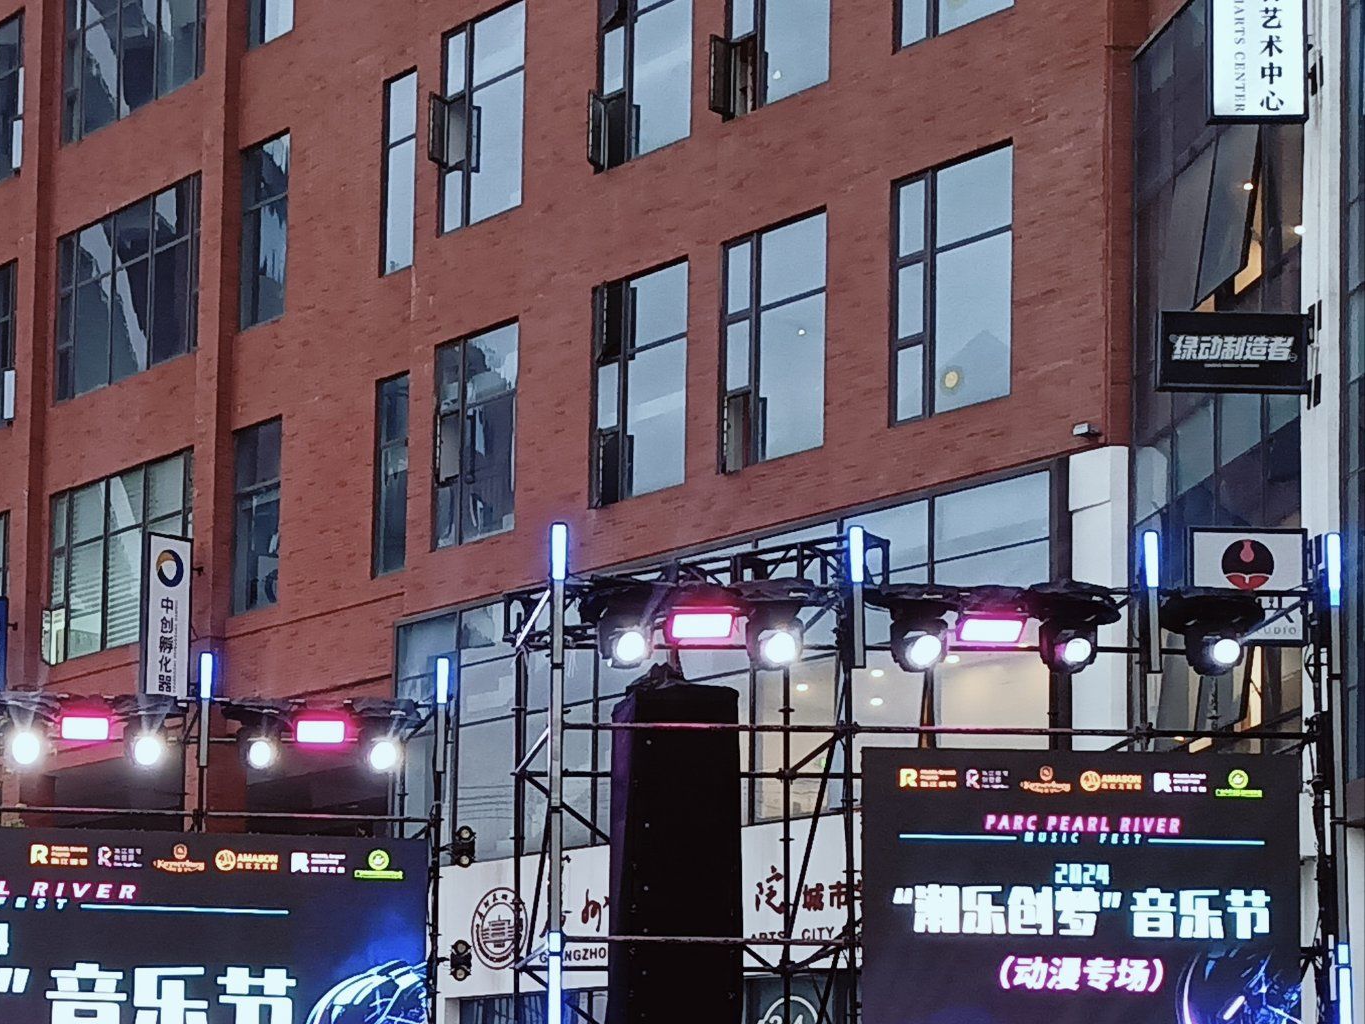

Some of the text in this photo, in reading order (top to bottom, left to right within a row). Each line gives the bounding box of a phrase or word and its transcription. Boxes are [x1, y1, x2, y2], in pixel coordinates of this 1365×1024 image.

[1258, 0, 1284, 111] 艺术中心
[1234, 52, 1246, 112] CENTER
[1171, 334, 1295, 361] 绿动制造者
[158, 597, 174, 692] 中创孵化器
[985, 815, 1181, 834] PARC PEARL RIVER
[1023, 832, 1143, 845] MUSIC FEST
[1054, 864, 1110, 885] 2024
[31, 882, 137, 899] RIVER
[539, 947, 607, 963] GNGZHO
[801, 926, 835, 941] CITY
